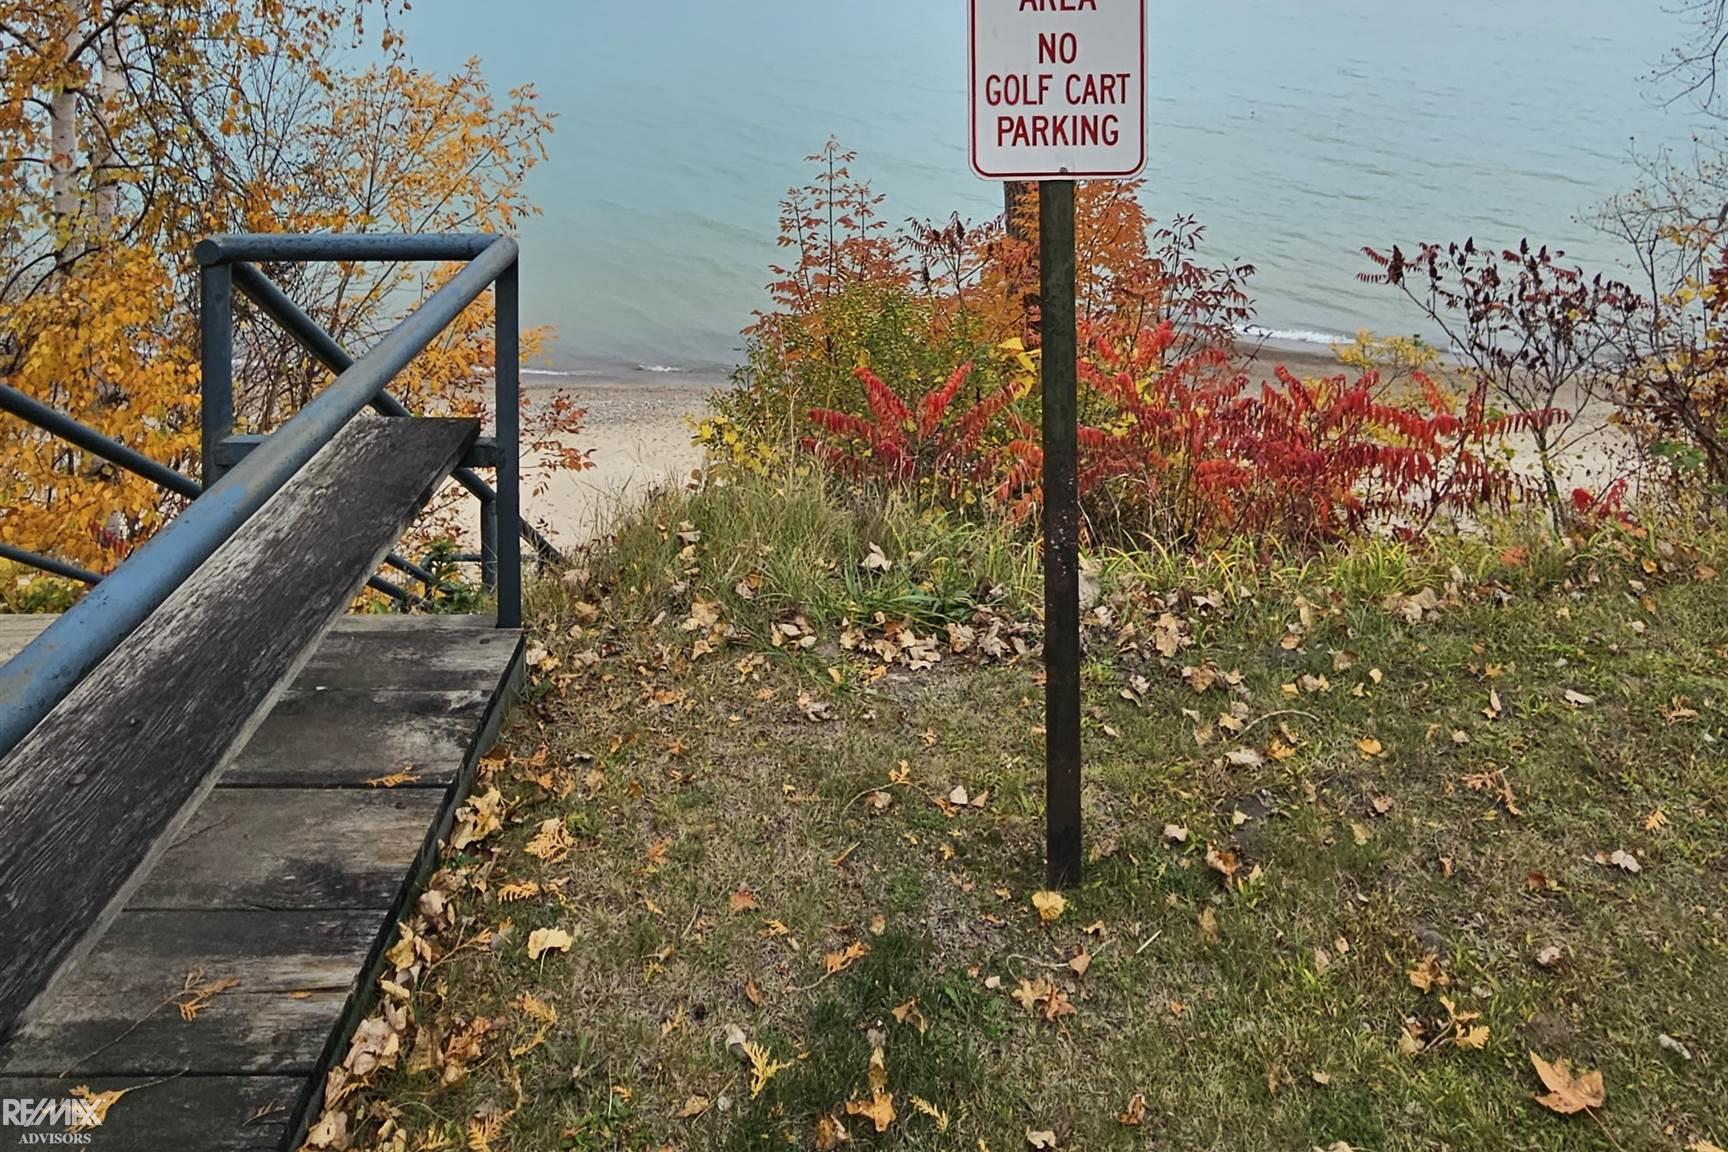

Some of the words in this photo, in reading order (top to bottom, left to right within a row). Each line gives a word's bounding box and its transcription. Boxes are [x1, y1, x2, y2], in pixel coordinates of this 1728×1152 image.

[1038, 32, 1078, 65] NO
[985, 74, 1054, 106] GOLF
[1065, 73, 1131, 105] CART
[996, 114, 1119, 147] PARKING
